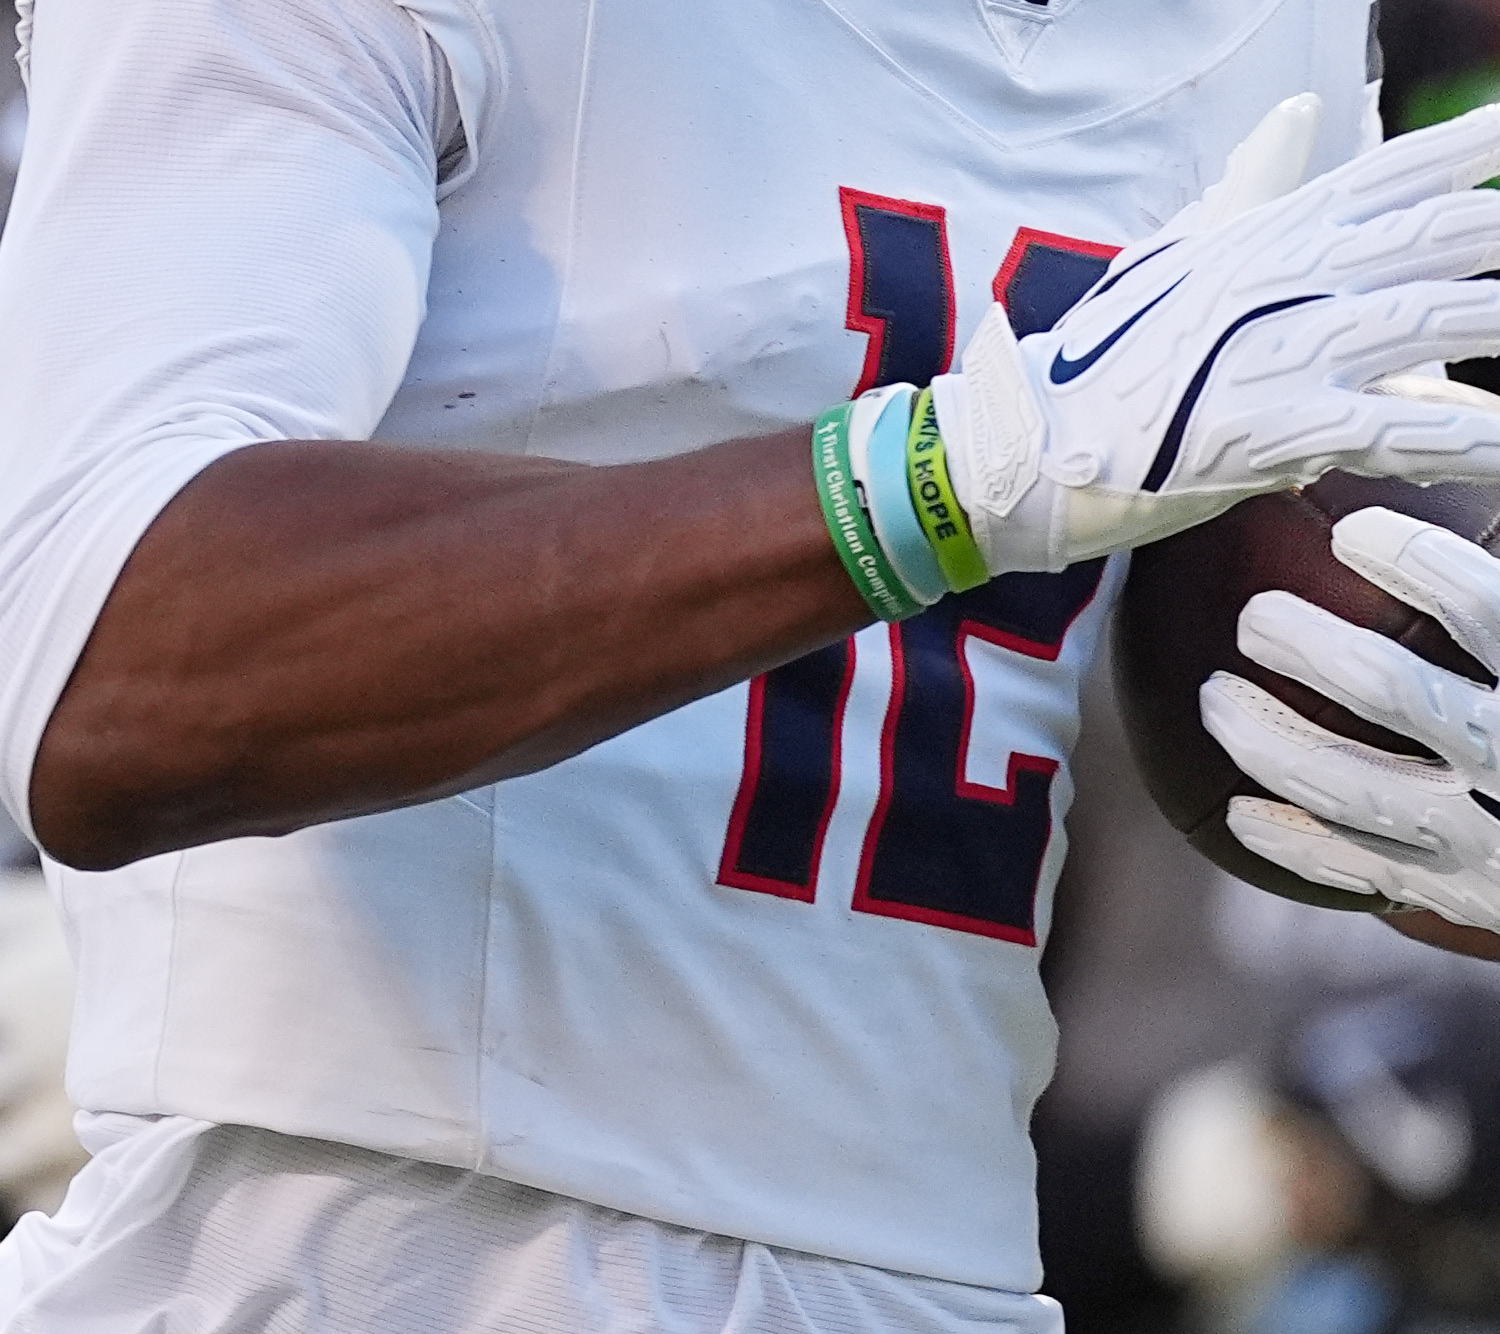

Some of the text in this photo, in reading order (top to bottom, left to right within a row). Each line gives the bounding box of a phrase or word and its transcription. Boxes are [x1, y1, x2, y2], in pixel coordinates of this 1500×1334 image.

[820, 433, 840, 468] First
[825, 469, 865, 554] Christian
[914, 459, 959, 541] HOPE
[716, 185, 1125, 947] 12
